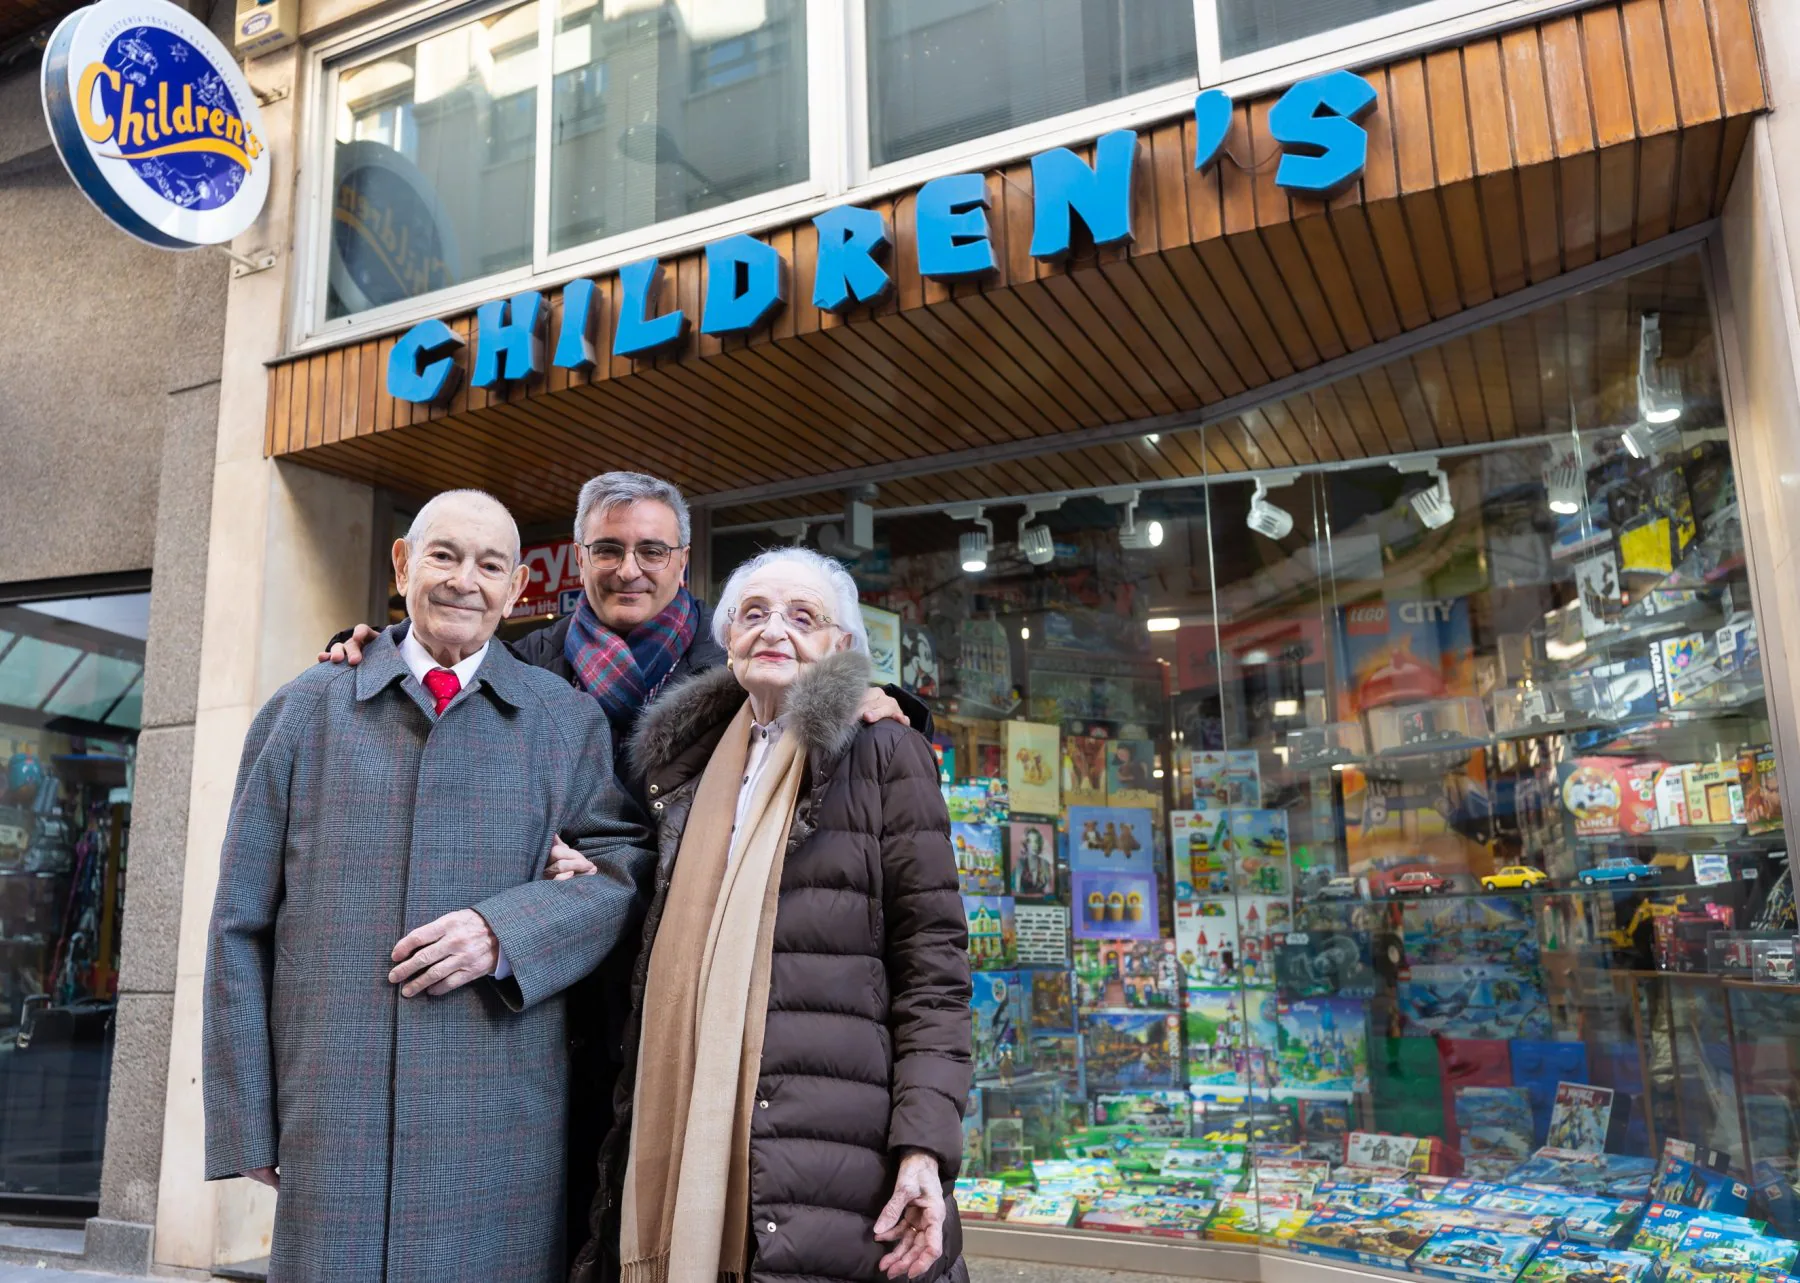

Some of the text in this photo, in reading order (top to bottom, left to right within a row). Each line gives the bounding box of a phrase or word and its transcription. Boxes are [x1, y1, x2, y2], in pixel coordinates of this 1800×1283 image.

[77, 61, 264, 160] Children's
[387, 70, 1377, 403] CHILDREN'S
[1350, 600, 1454, 623] LEGO CITY
[1664, 1208, 1683, 1219] CITY
[1703, 1231, 1722, 1240] CITY
[1561, 1244, 1580, 1252] CITY
